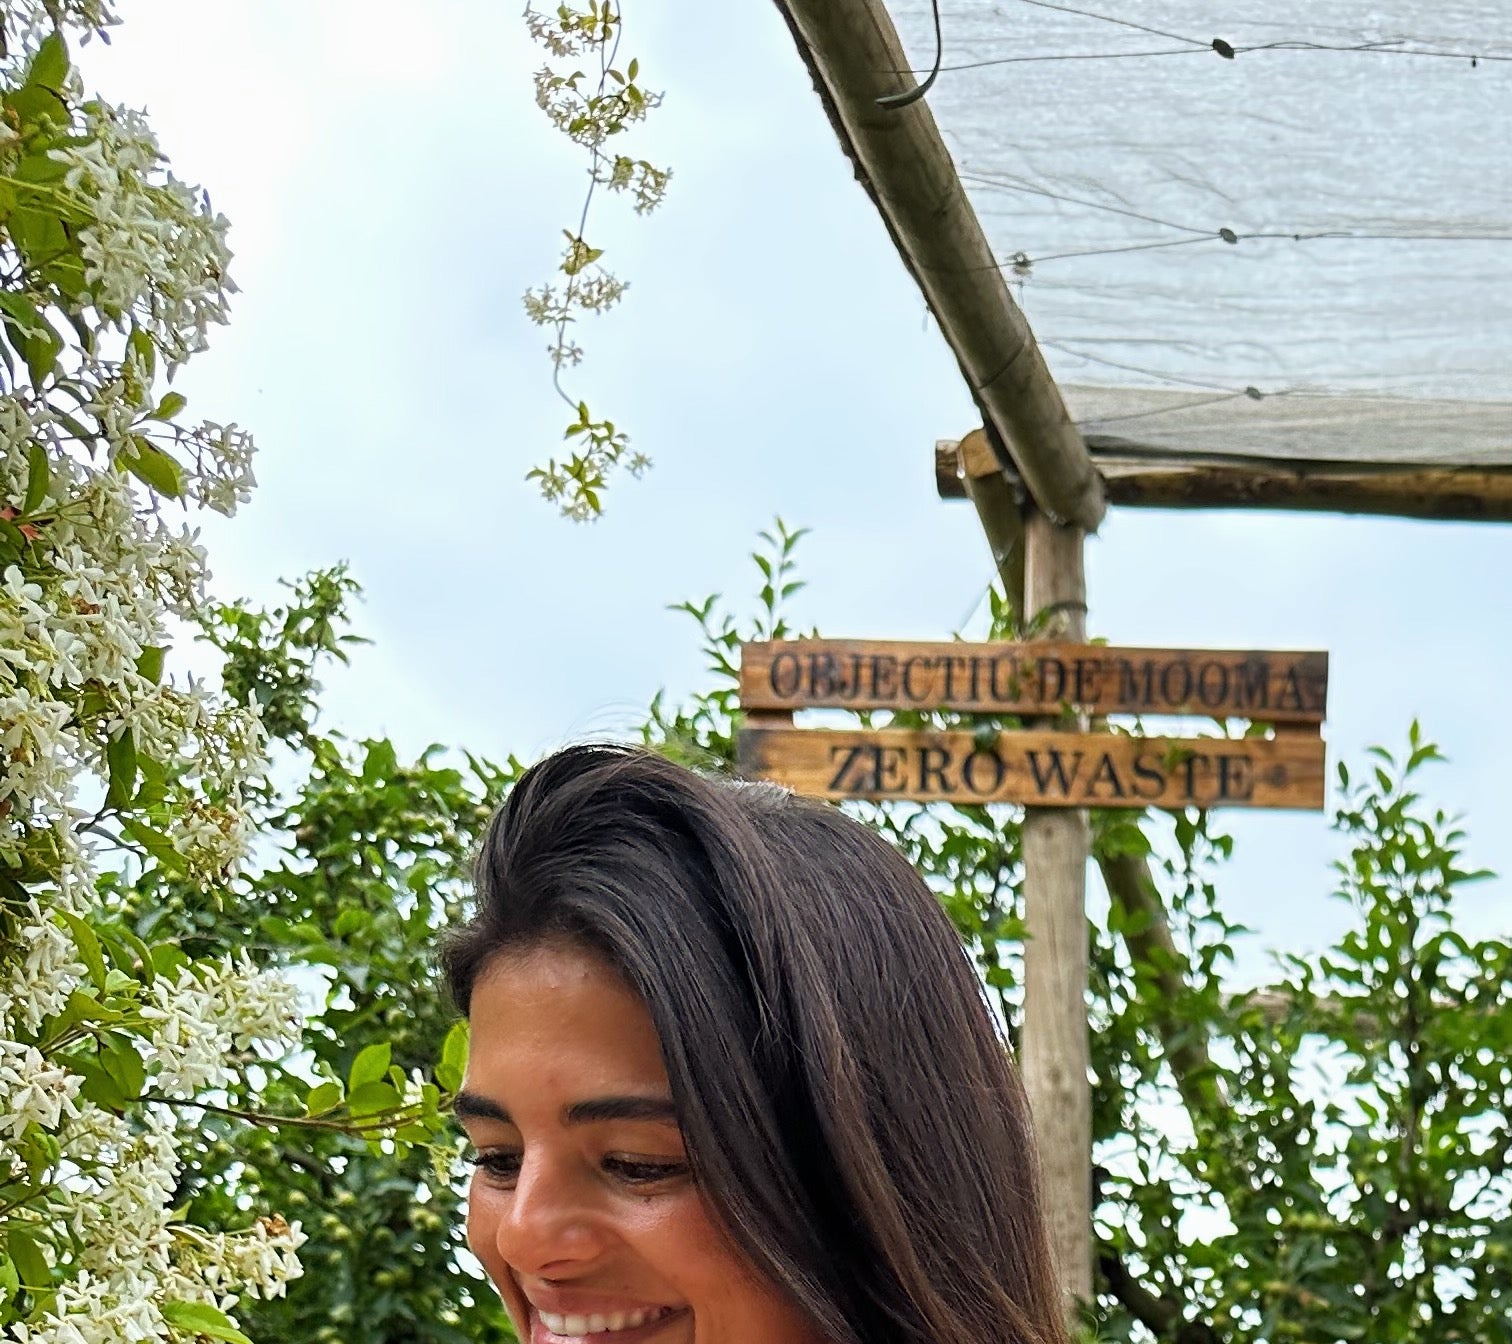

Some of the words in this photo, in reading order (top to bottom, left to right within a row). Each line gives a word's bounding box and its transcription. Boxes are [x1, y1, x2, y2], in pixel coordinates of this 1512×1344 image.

[1036, 656, 1101, 704] DE
[1117, 658, 1310, 712] MOOMA
[827, 744, 1006, 796] ZERO
[1025, 749, 1253, 800] WASTE
